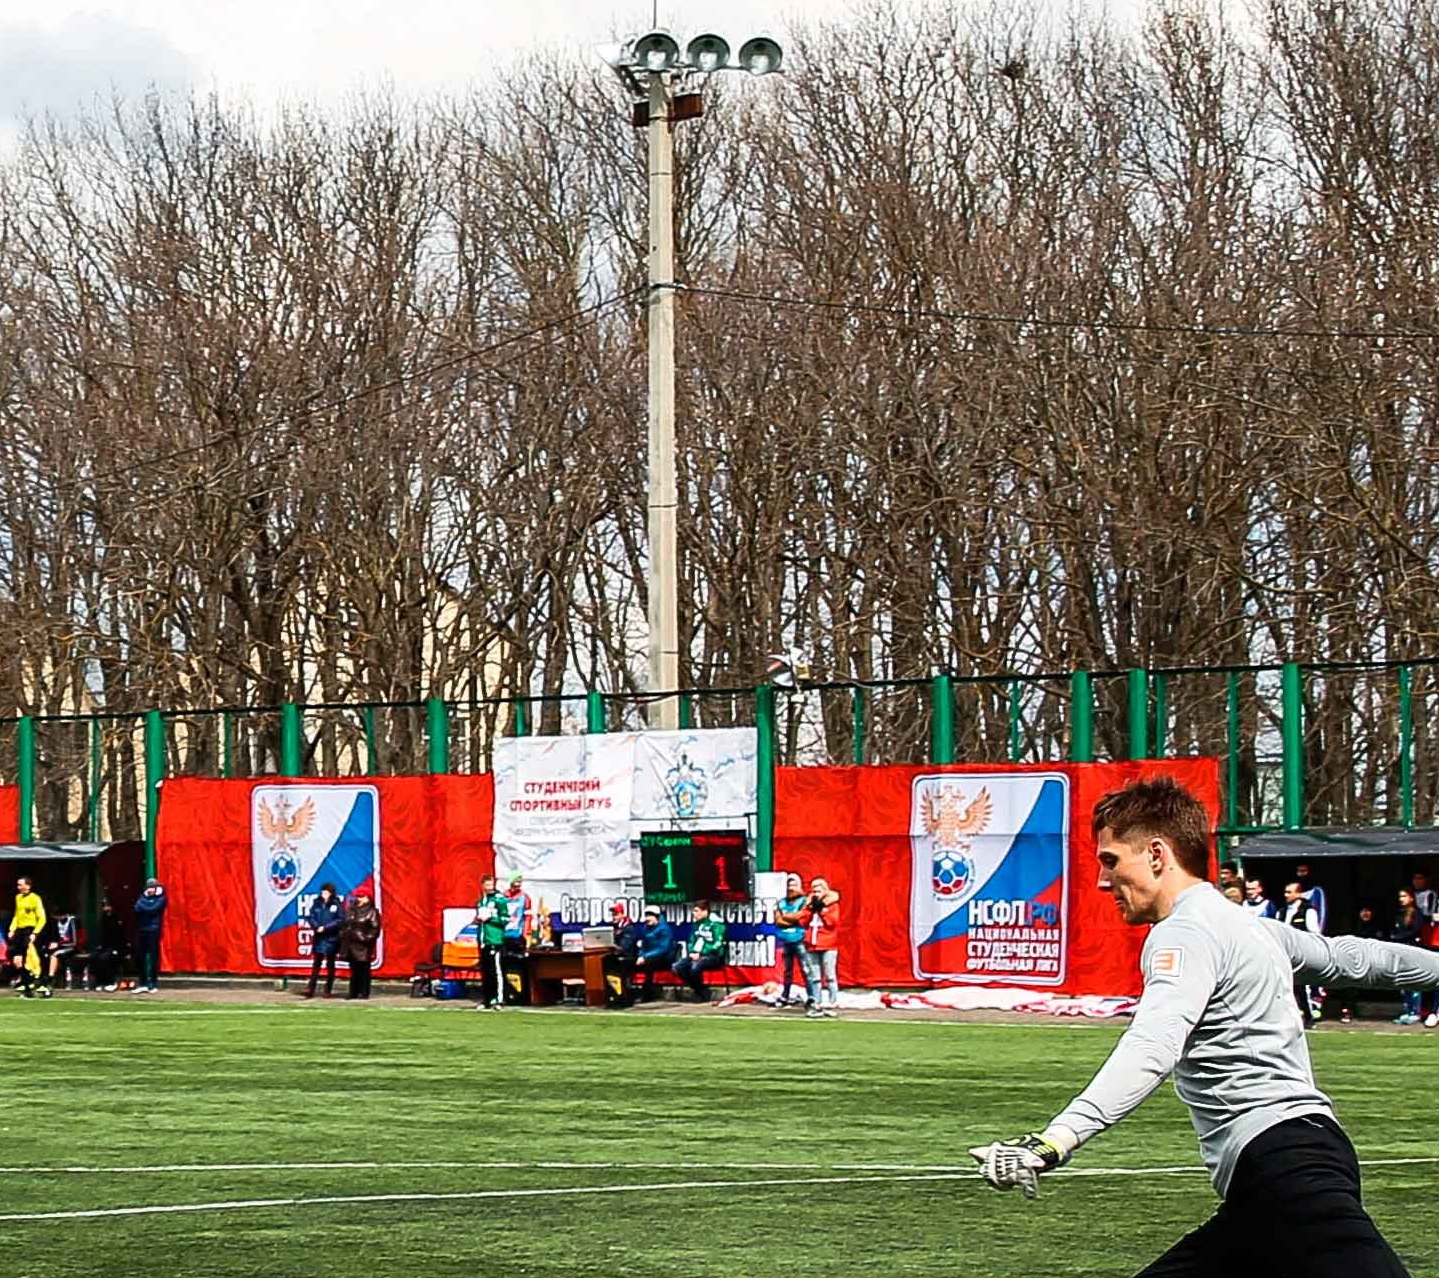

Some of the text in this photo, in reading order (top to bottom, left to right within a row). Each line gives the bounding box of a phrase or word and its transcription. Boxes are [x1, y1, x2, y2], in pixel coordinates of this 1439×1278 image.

[662, 854, 677, 889] 1
[715, 856, 730, 890] 1
[968, 928, 1060, 940] НАЦИОНАЛЬНАЯ
[967, 941, 1060, 959] СТУДЕНЧЕСКАЯ
